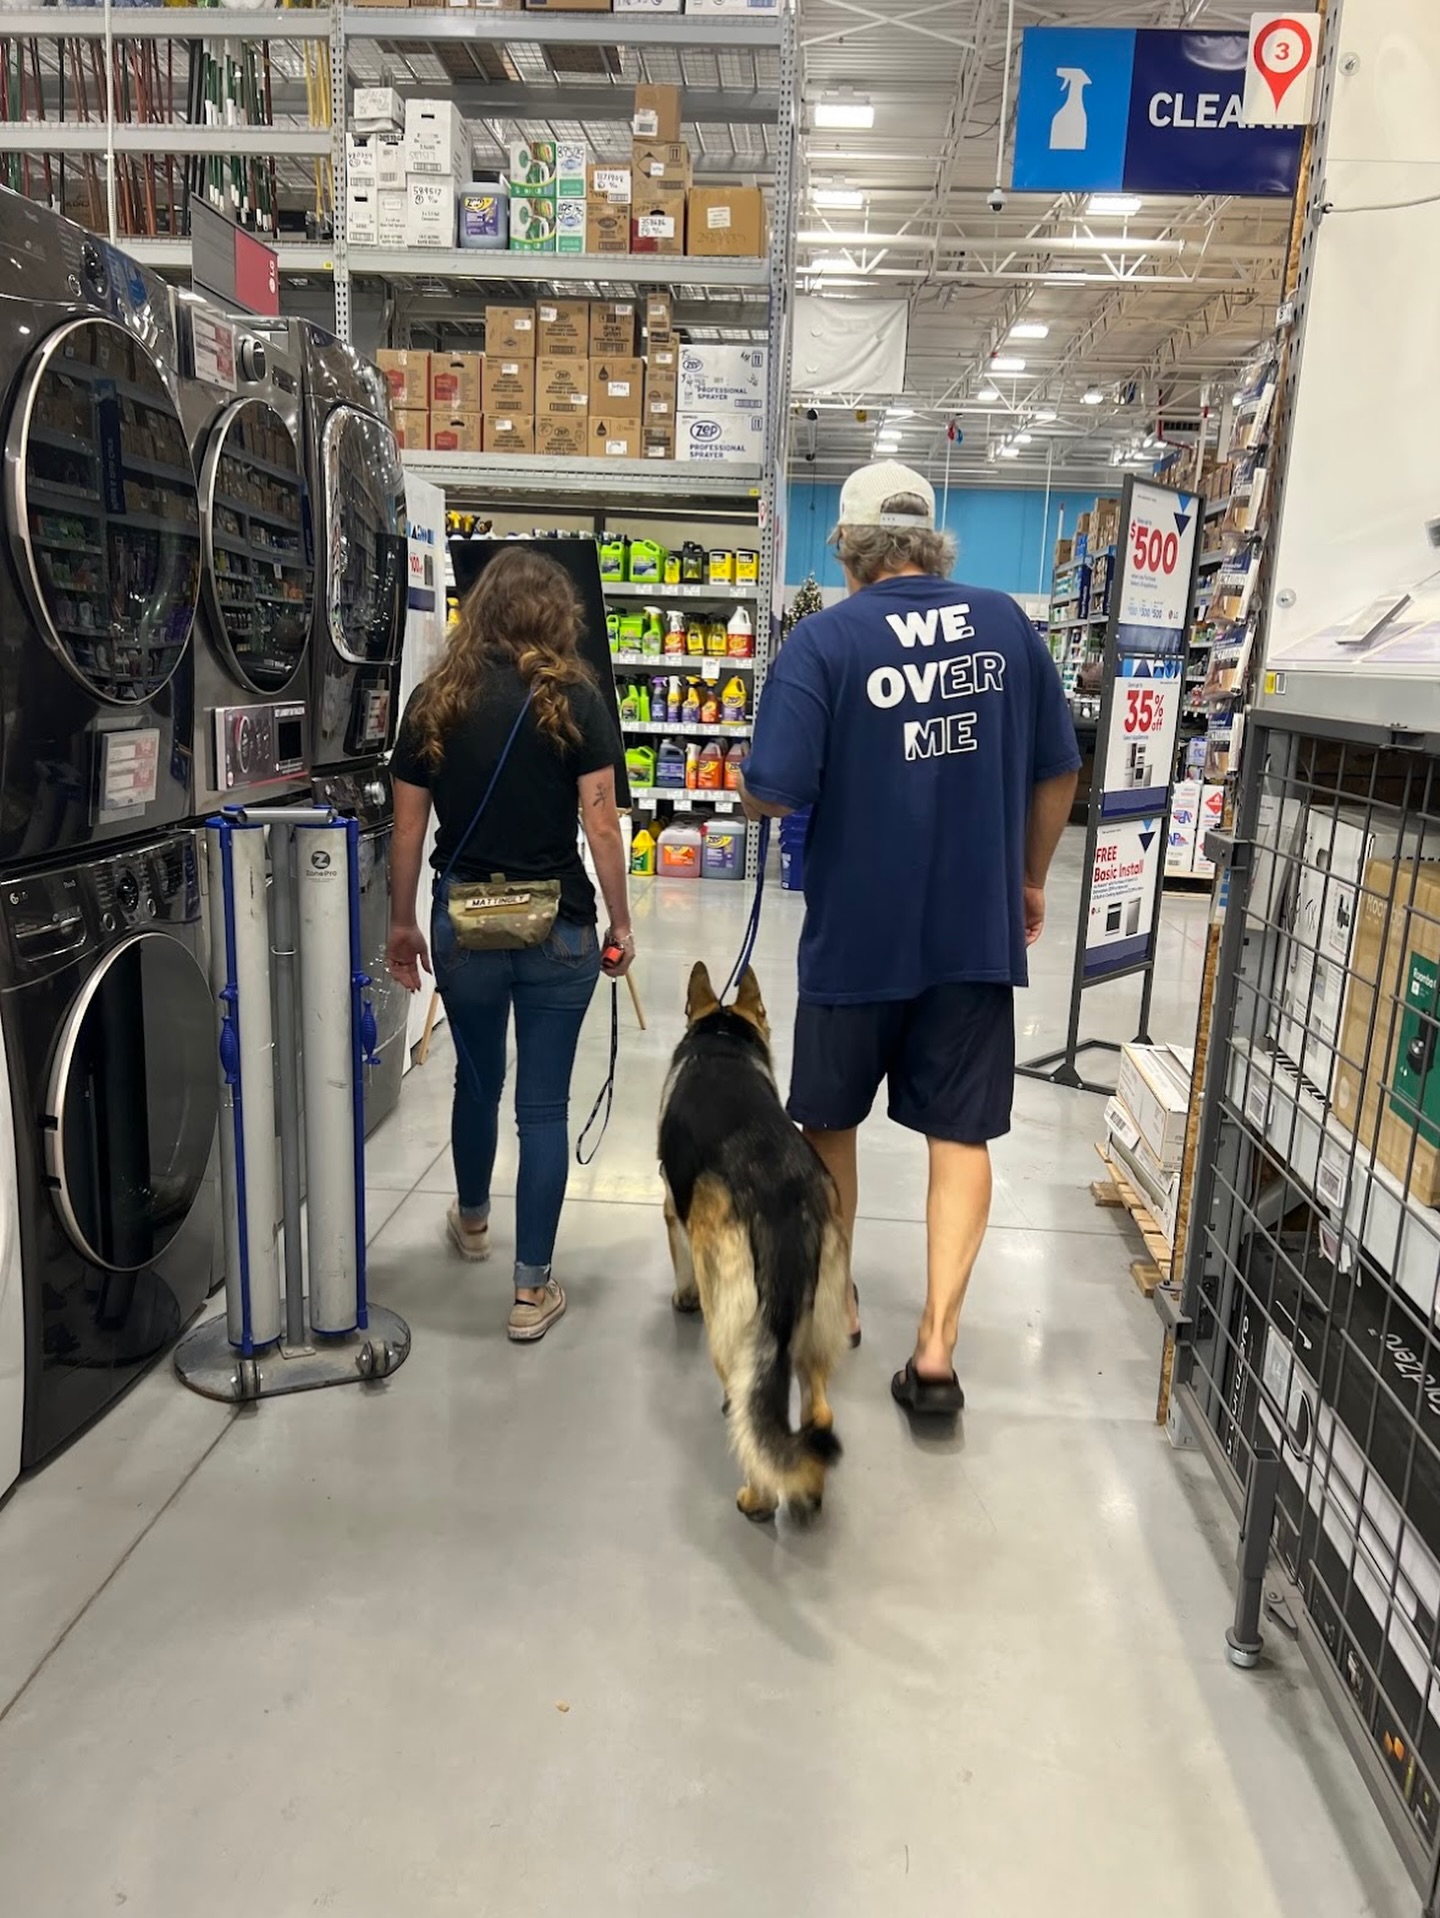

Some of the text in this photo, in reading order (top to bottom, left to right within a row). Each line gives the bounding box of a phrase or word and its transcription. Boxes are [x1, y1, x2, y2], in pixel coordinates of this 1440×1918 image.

[1274, 41, 1290, 61] 3
[1149, 92, 1294, 129] CLEA
[697, 386, 748, 395] PROFESSIONAL
[689, 444, 746, 452] PROFESSIONAL
[689, 451, 724, 459] SPRAYER
[1130, 519, 1178, 575] $500
[885, 603, 975, 648] WE
[866, 651, 1006, 709] OVER
[1151, 717, 1163, 731] off
[903, 711, 978, 761] ME
[1096, 845, 1118, 863] FREE
[1093, 858, 1145, 882] Basic Install
